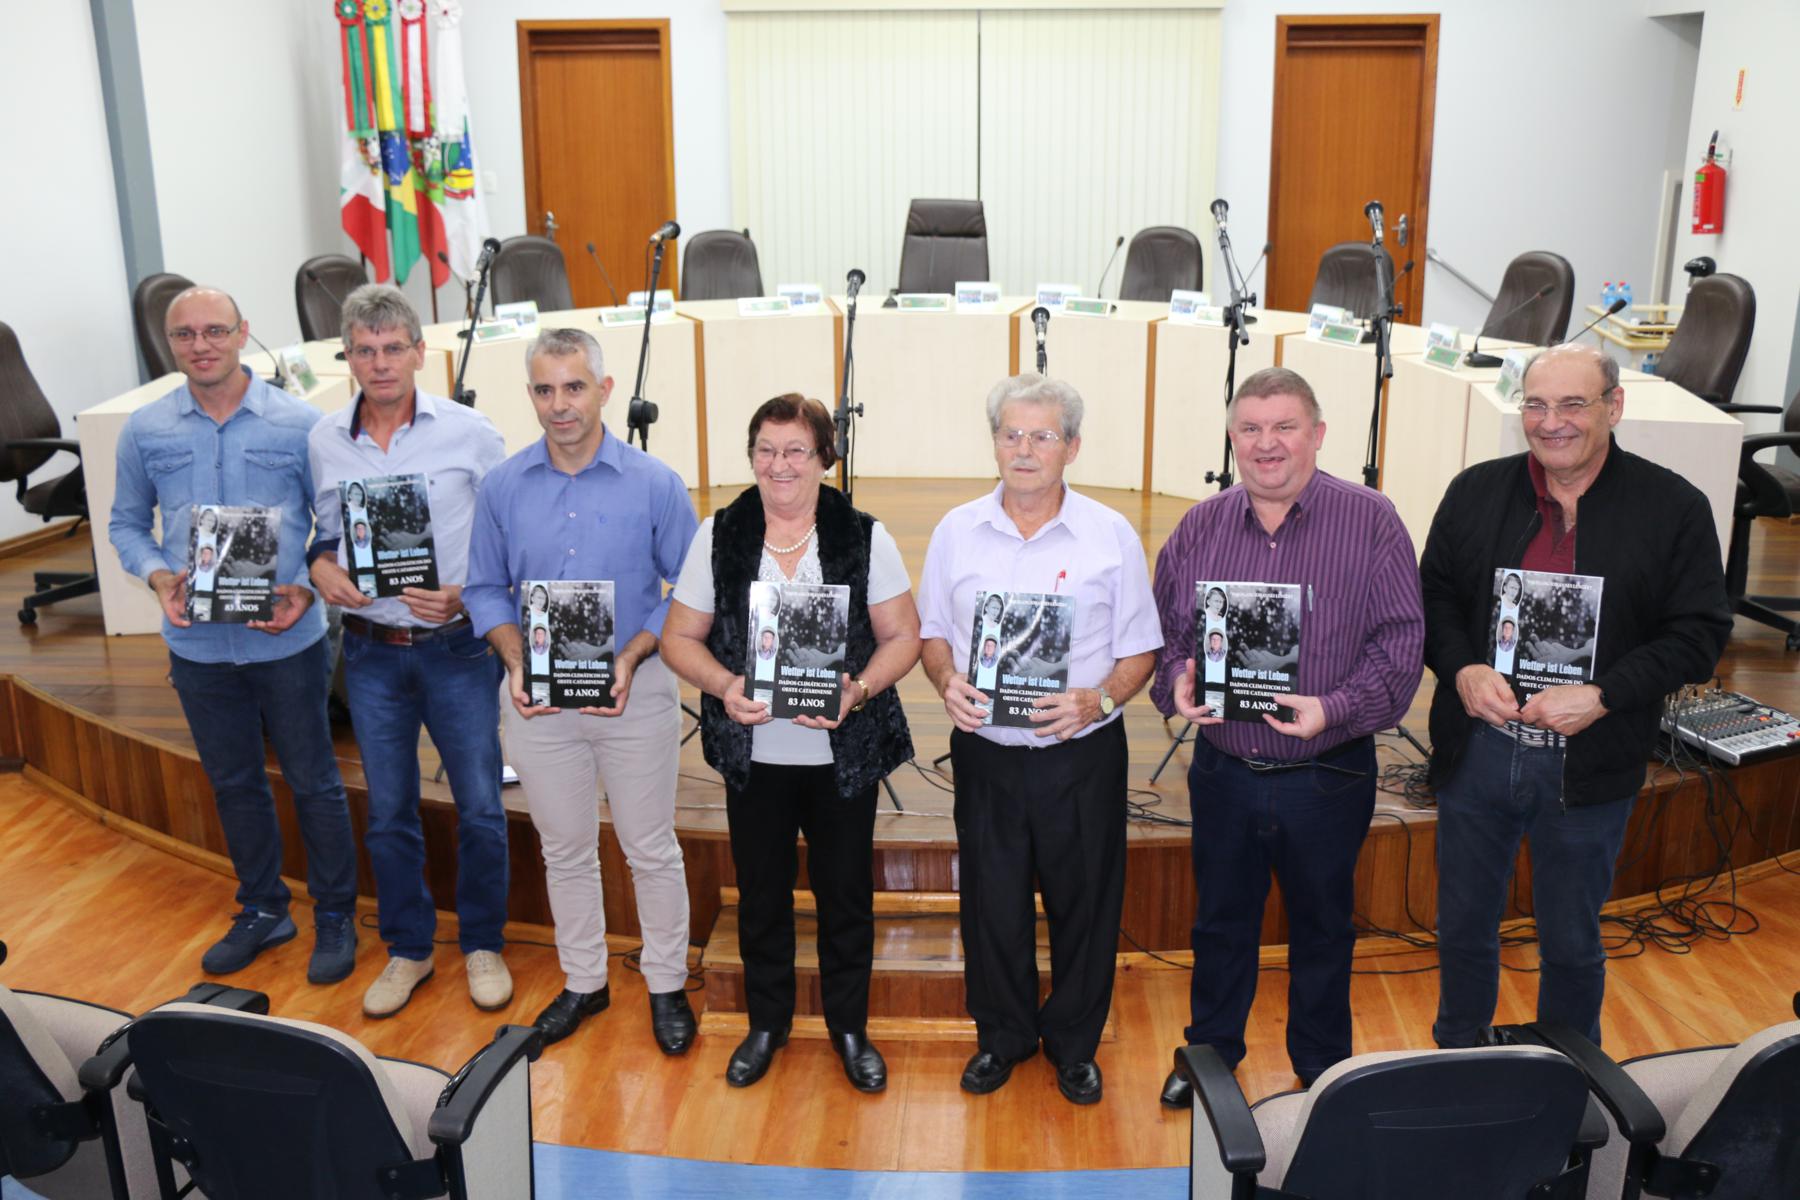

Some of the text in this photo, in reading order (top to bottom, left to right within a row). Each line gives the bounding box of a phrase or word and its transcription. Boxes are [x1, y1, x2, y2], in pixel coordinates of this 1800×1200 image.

[400, 574, 424, 584] ANOS
[806, 667, 815, 678] ist
[1520, 659, 1582, 675] Wetter ist Leben
[1258, 669, 1267, 680] ist
[1268, 670, 1289, 681] Leben
[788, 698, 825, 707] 83 ANOS
[1240, 700, 1278, 711] 83 ANOS
